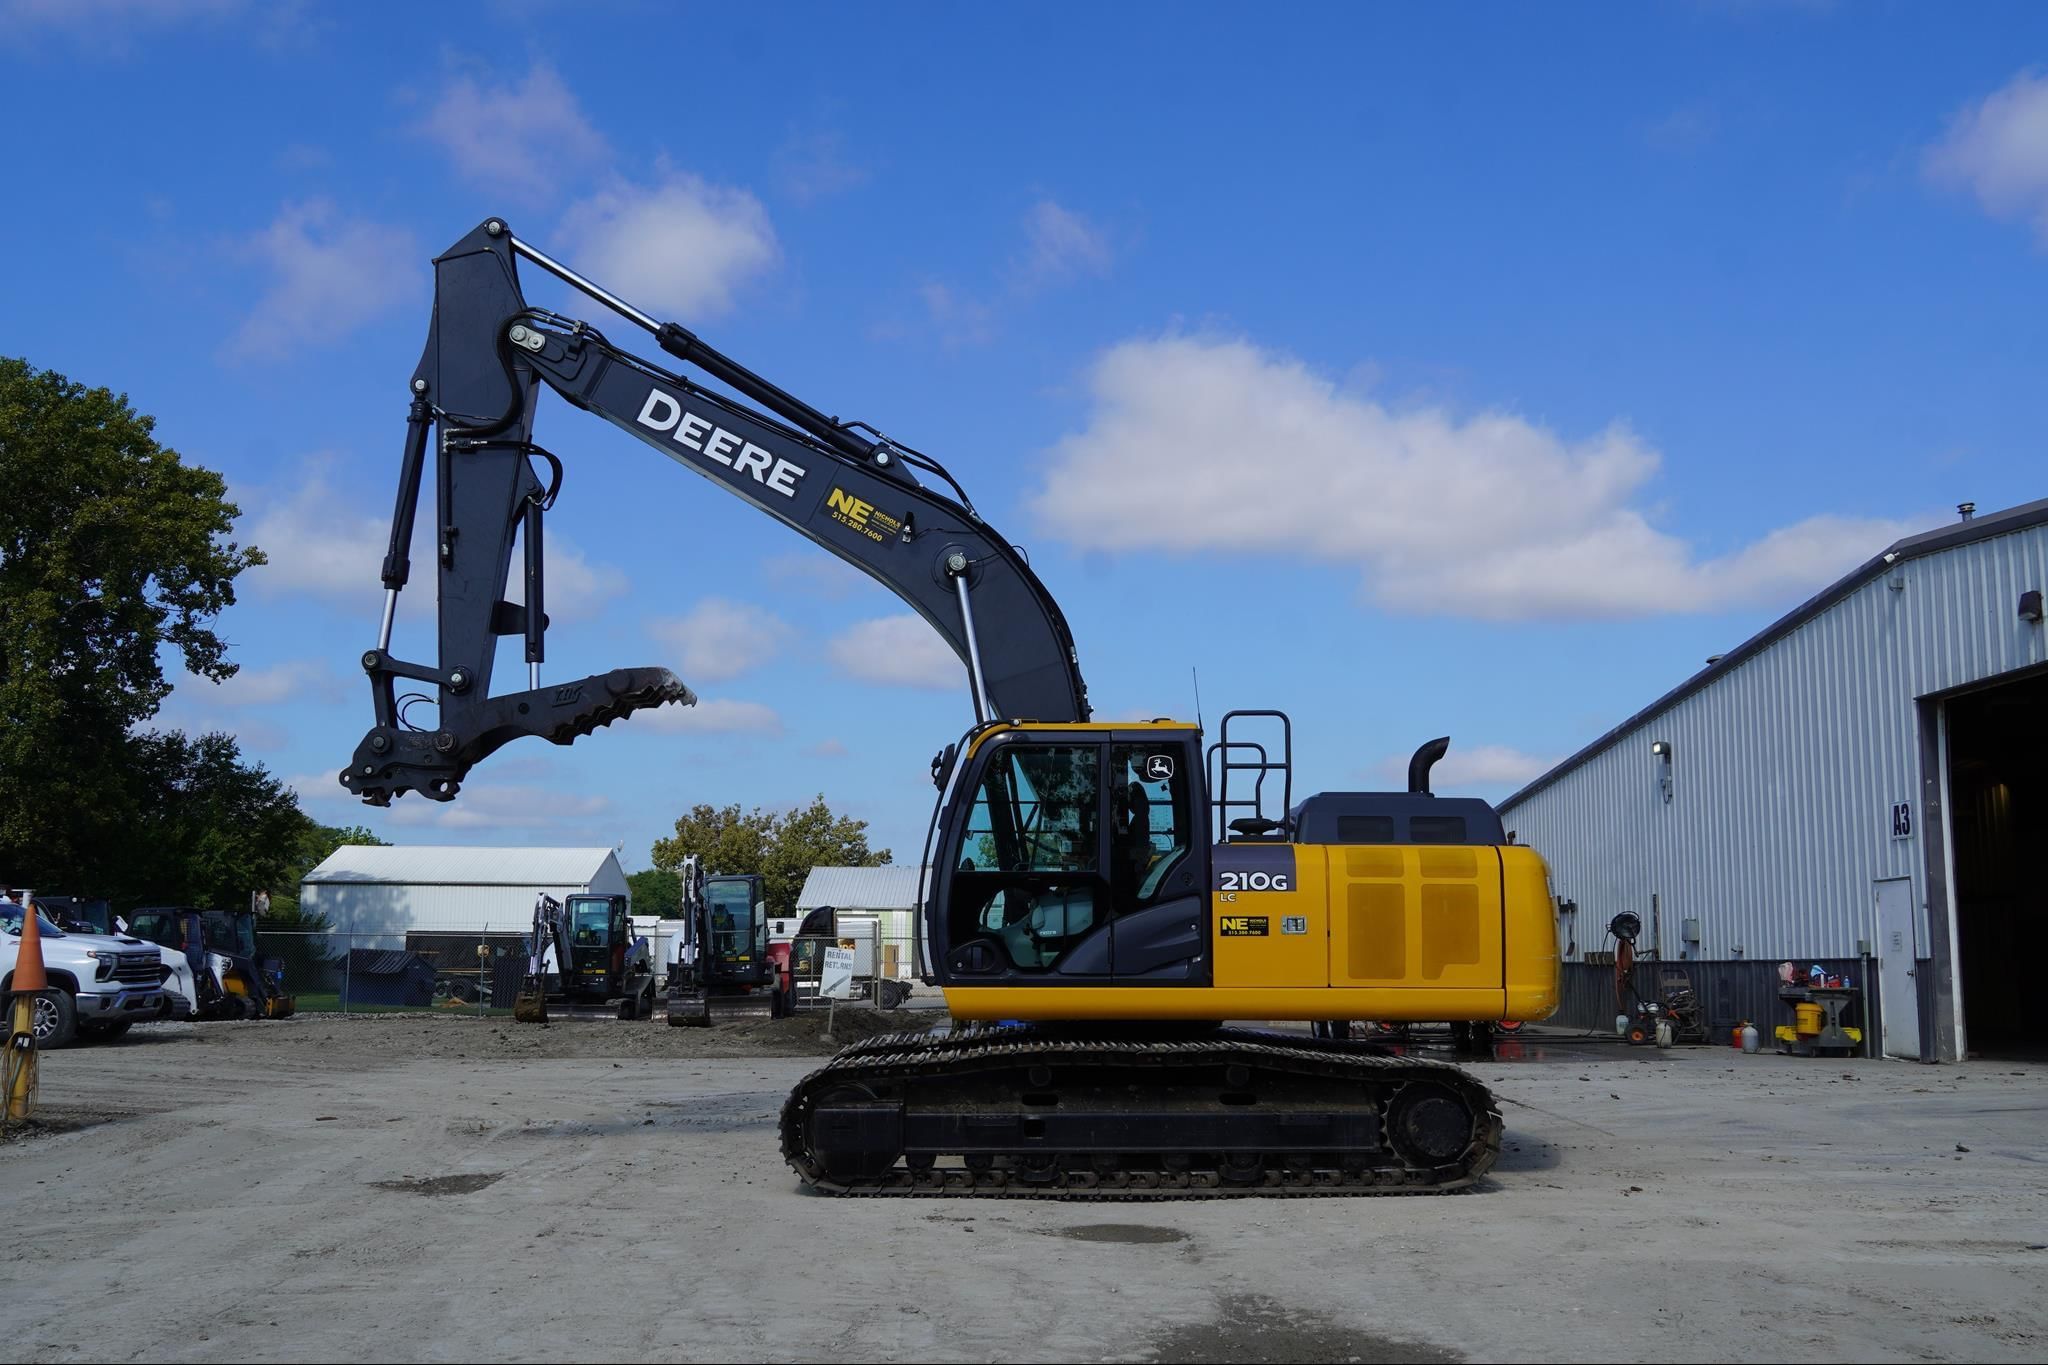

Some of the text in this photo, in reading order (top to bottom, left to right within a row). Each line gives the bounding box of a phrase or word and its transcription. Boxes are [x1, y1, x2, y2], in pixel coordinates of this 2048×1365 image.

[636, 388, 805, 498] DEERE
[827, 488, 874, 525] NE
[831, 511, 883, 542] 515.280.7600
[1893, 803, 1911, 836] A3
[1220, 872, 1287, 891] 210G
[1220, 893, 1236, 902] LC
[1222, 918, 1249, 930] NE
[827, 951, 852, 961] RENTAL
